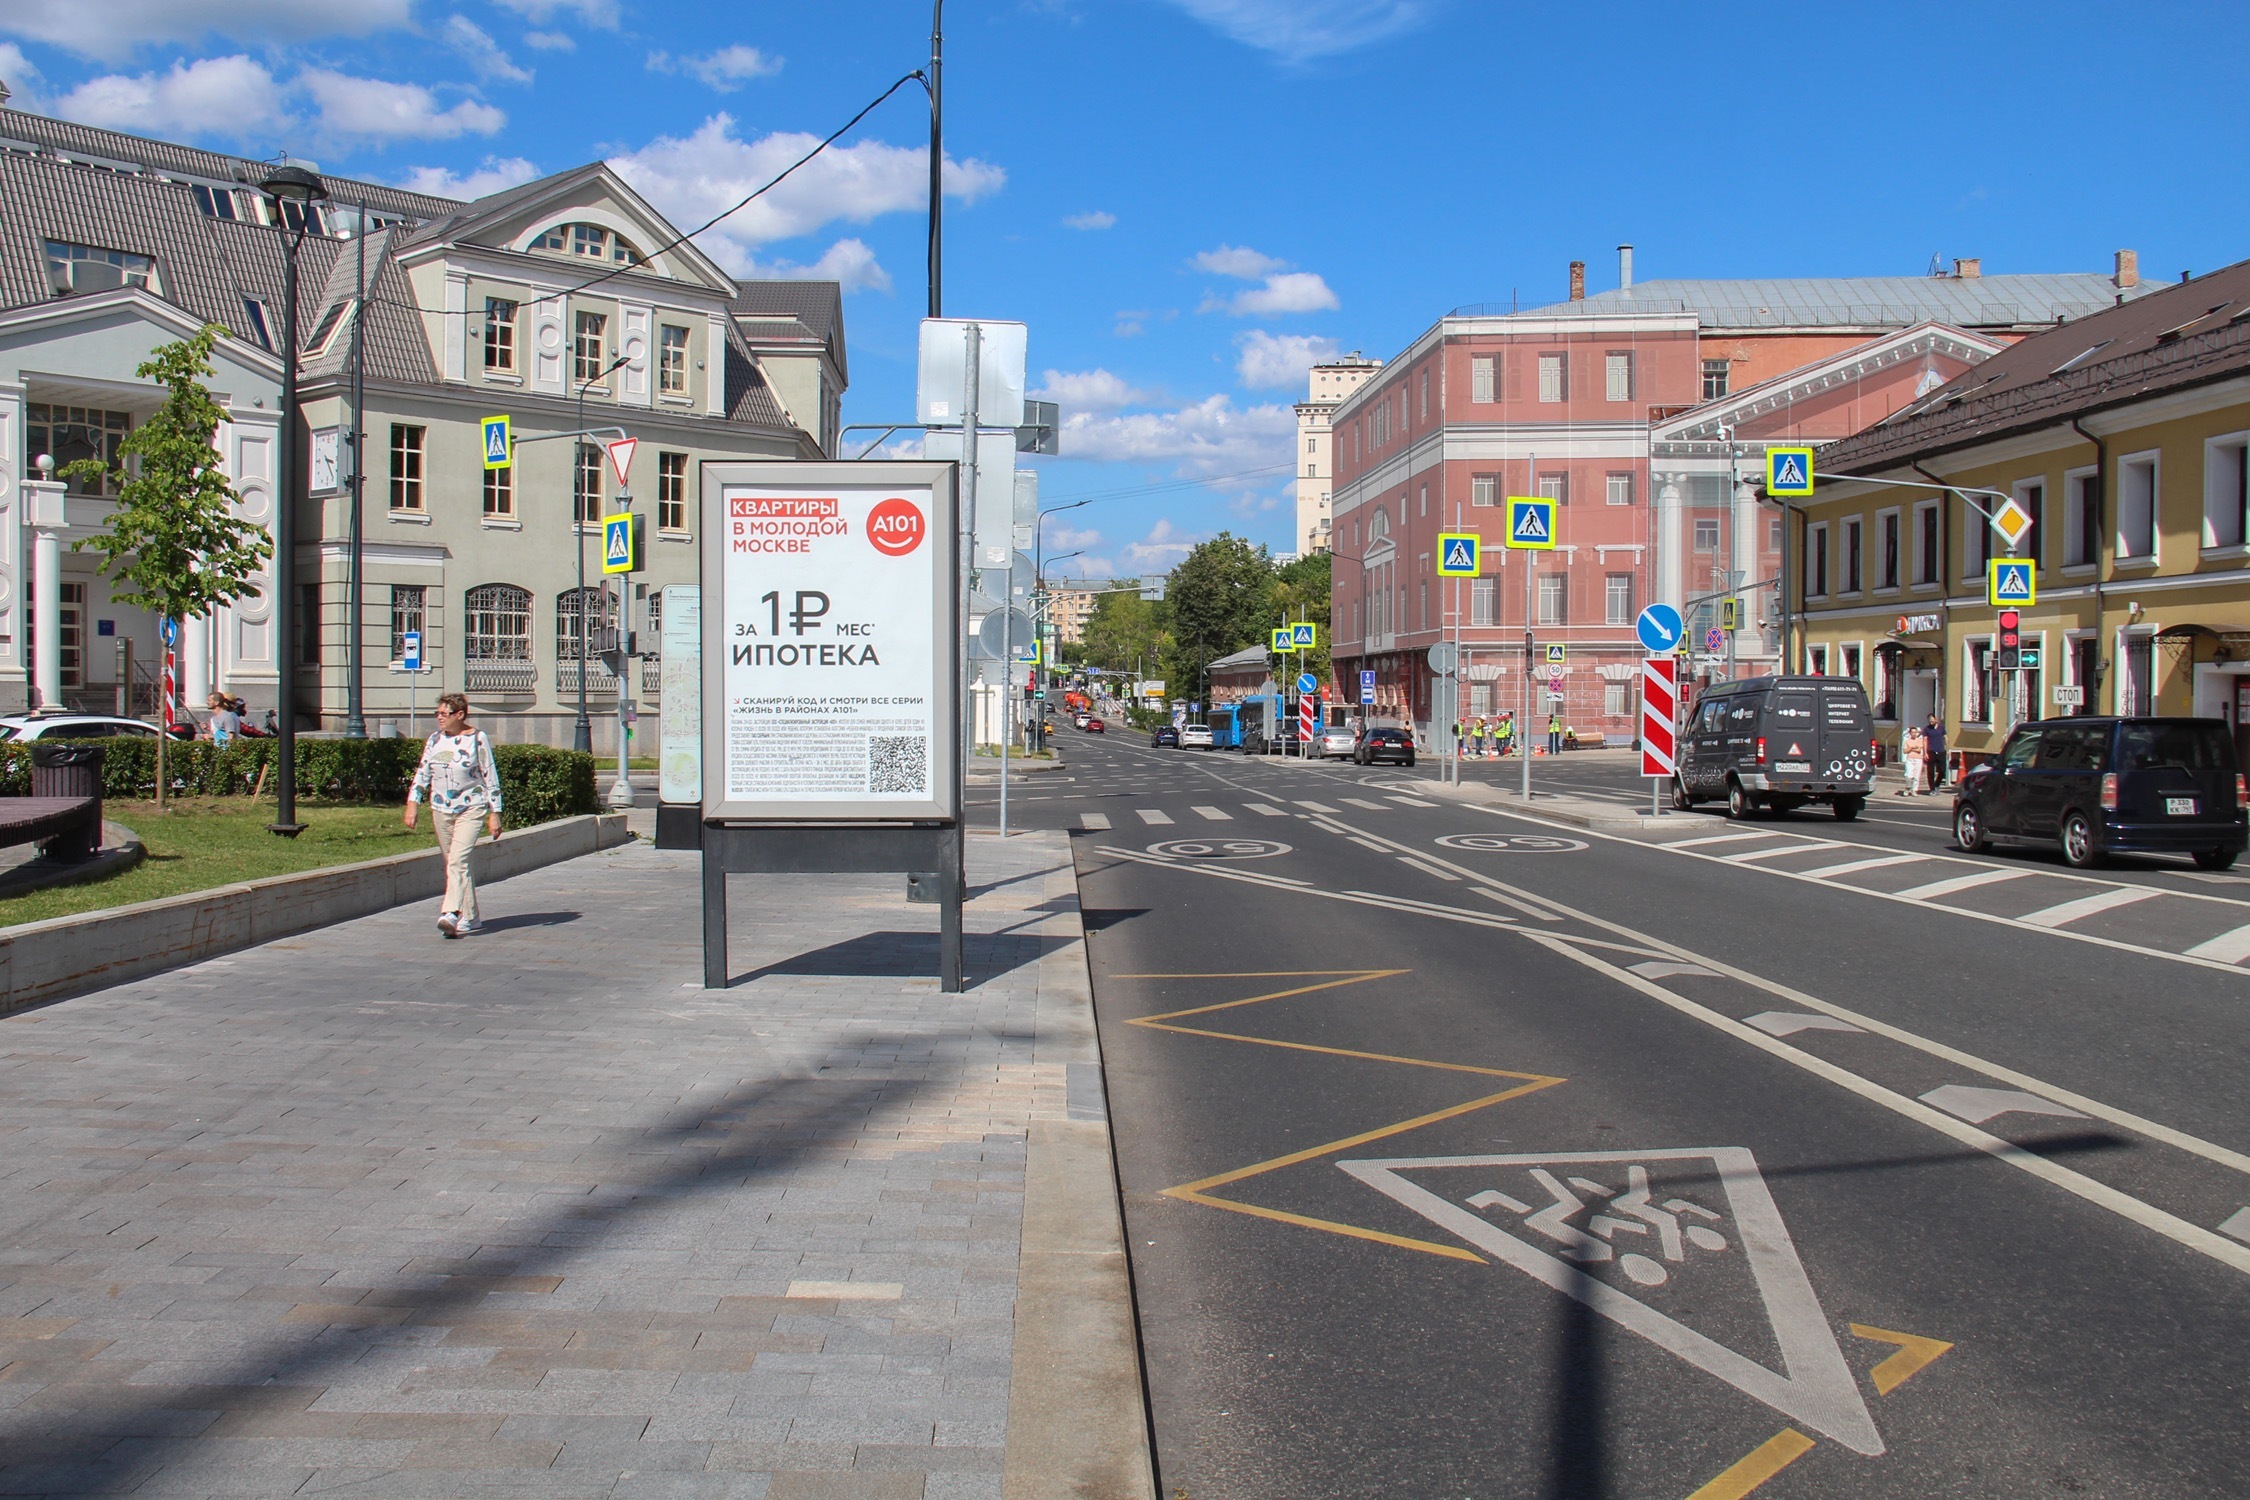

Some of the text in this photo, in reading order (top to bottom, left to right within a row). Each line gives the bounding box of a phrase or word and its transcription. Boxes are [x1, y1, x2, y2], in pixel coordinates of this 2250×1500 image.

[732, 501, 836, 515] КВАРТИРЫ
[733, 518, 848, 537] В МОЛОДОЙ
[733, 539, 811, 553] МОСКВЕ
[735, 624, 758, 636] ЗА
[732, 644, 880, 666] ИПОТЕКА
[743, 696, 924, 706] СКАНИРУЙ КОД И СМОТРИ ВСЕ СЕРИИ
[2056, 688, 2079, 702] СТОП
[732, 706, 773, 714] «ЖИЗНЬ
[775, 706, 782, 714] В
[784, 705, 830, 714] РАЙОНАХ
[1170, 842, 1265, 854] 50
[1459, 837, 1564, 848] 50
